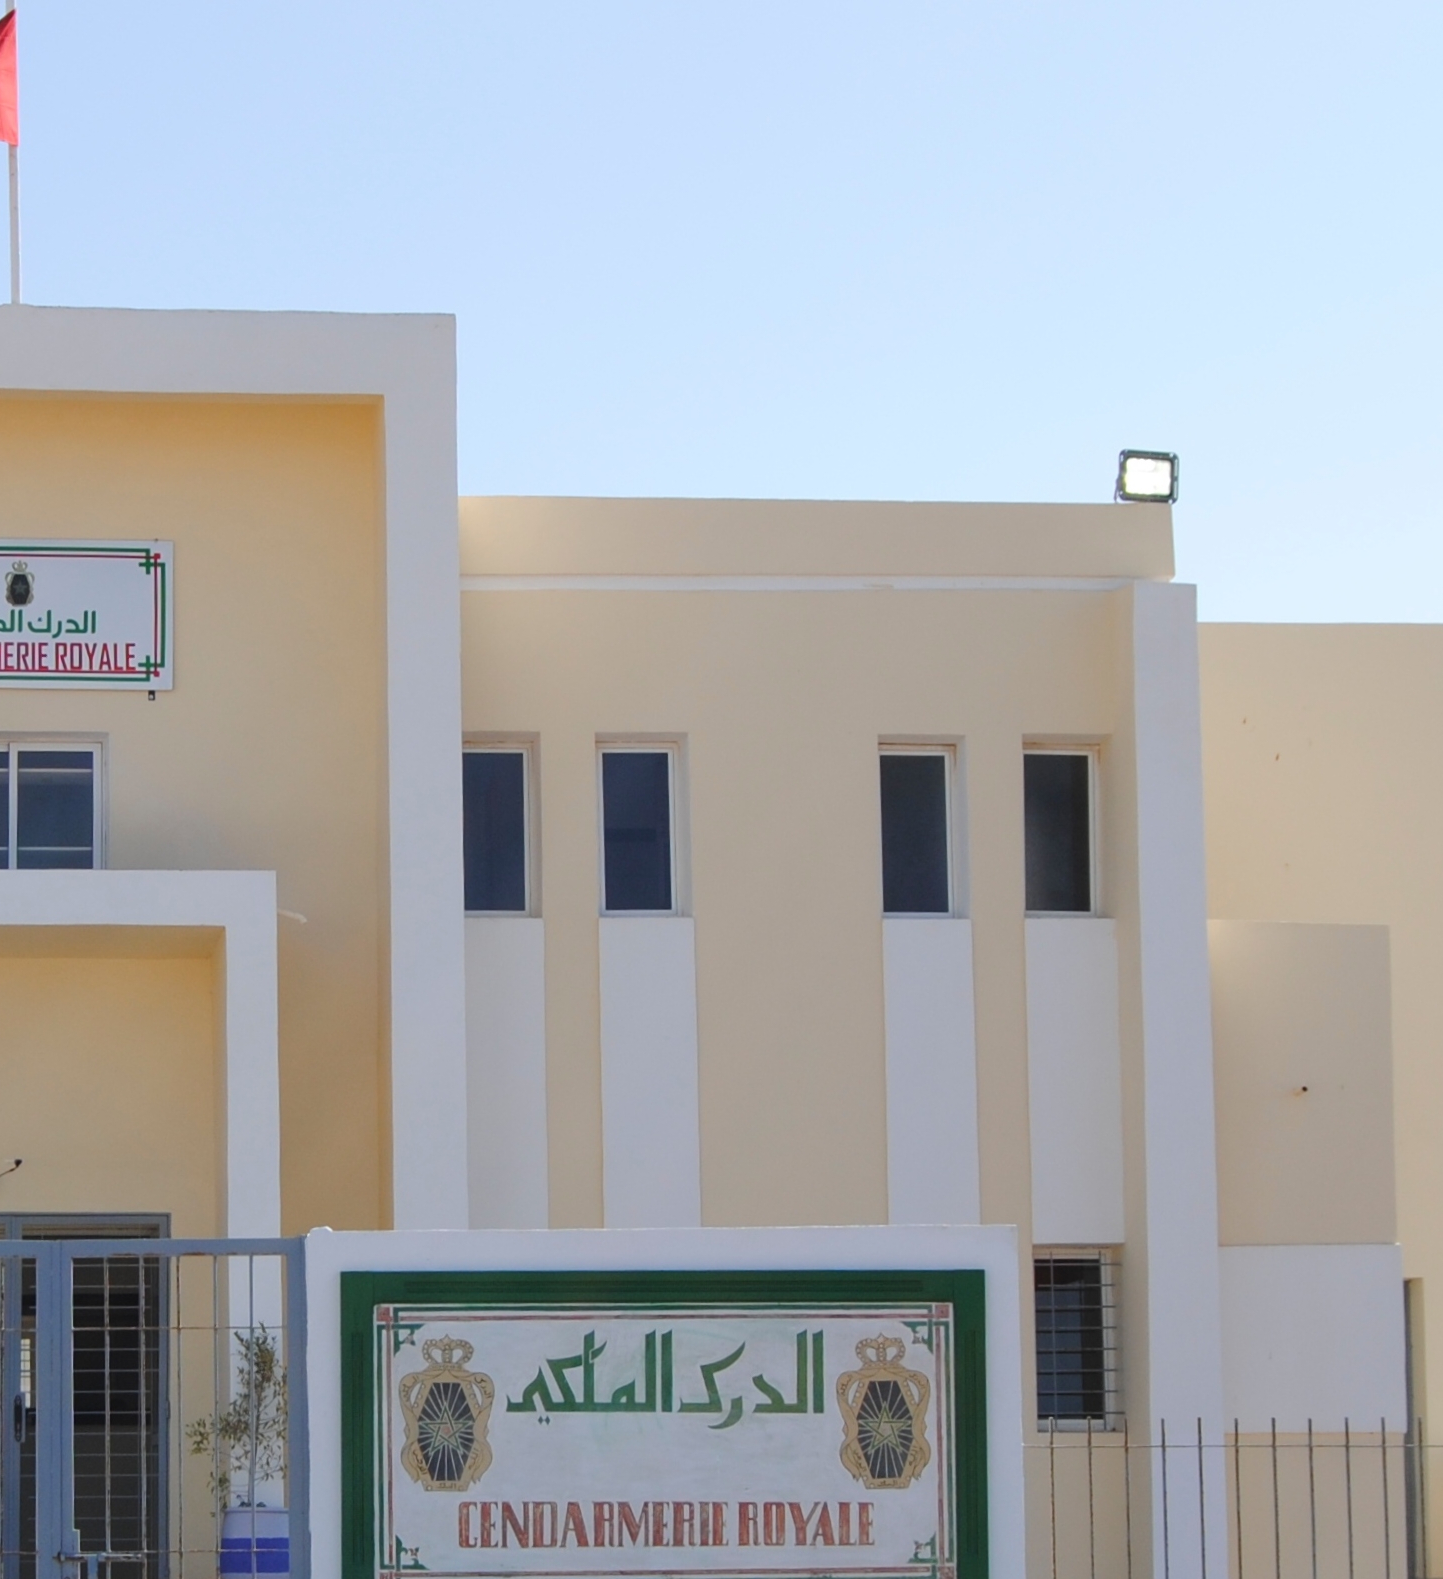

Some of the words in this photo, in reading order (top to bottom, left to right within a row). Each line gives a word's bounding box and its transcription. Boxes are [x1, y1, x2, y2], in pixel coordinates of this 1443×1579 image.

[28, 609, 96, 639] الدرك
[55, 642, 136, 671] ROYALE
[505, 1329, 674, 1426] الملكي
[677, 1329, 825, 1430] الدرك
[737, 1501, 875, 1547] ROYALE
